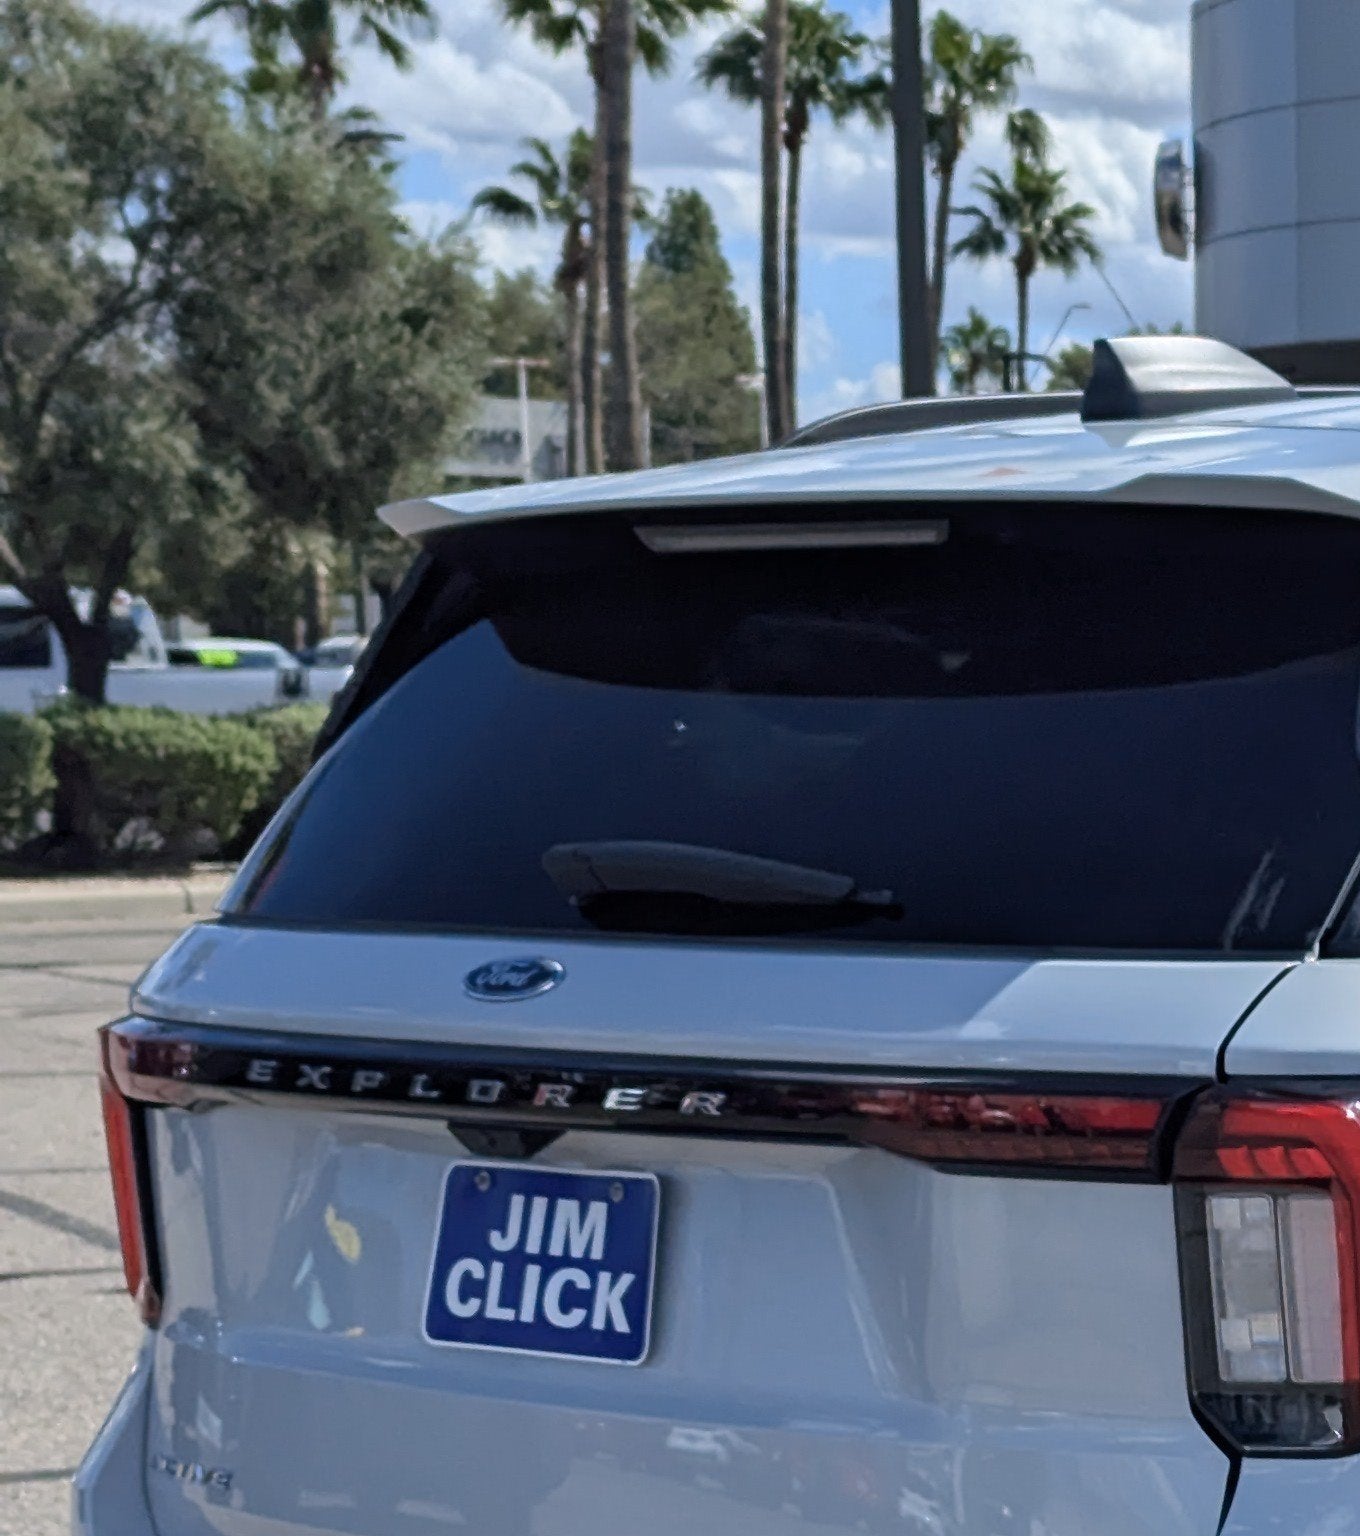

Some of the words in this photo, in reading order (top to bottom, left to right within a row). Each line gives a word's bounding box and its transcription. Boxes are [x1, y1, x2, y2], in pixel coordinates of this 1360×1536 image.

[245, 1059, 728, 1116] EXPLORER
[487, 1193, 609, 1260] JIM
[445, 1257, 636, 1334] CLICK
